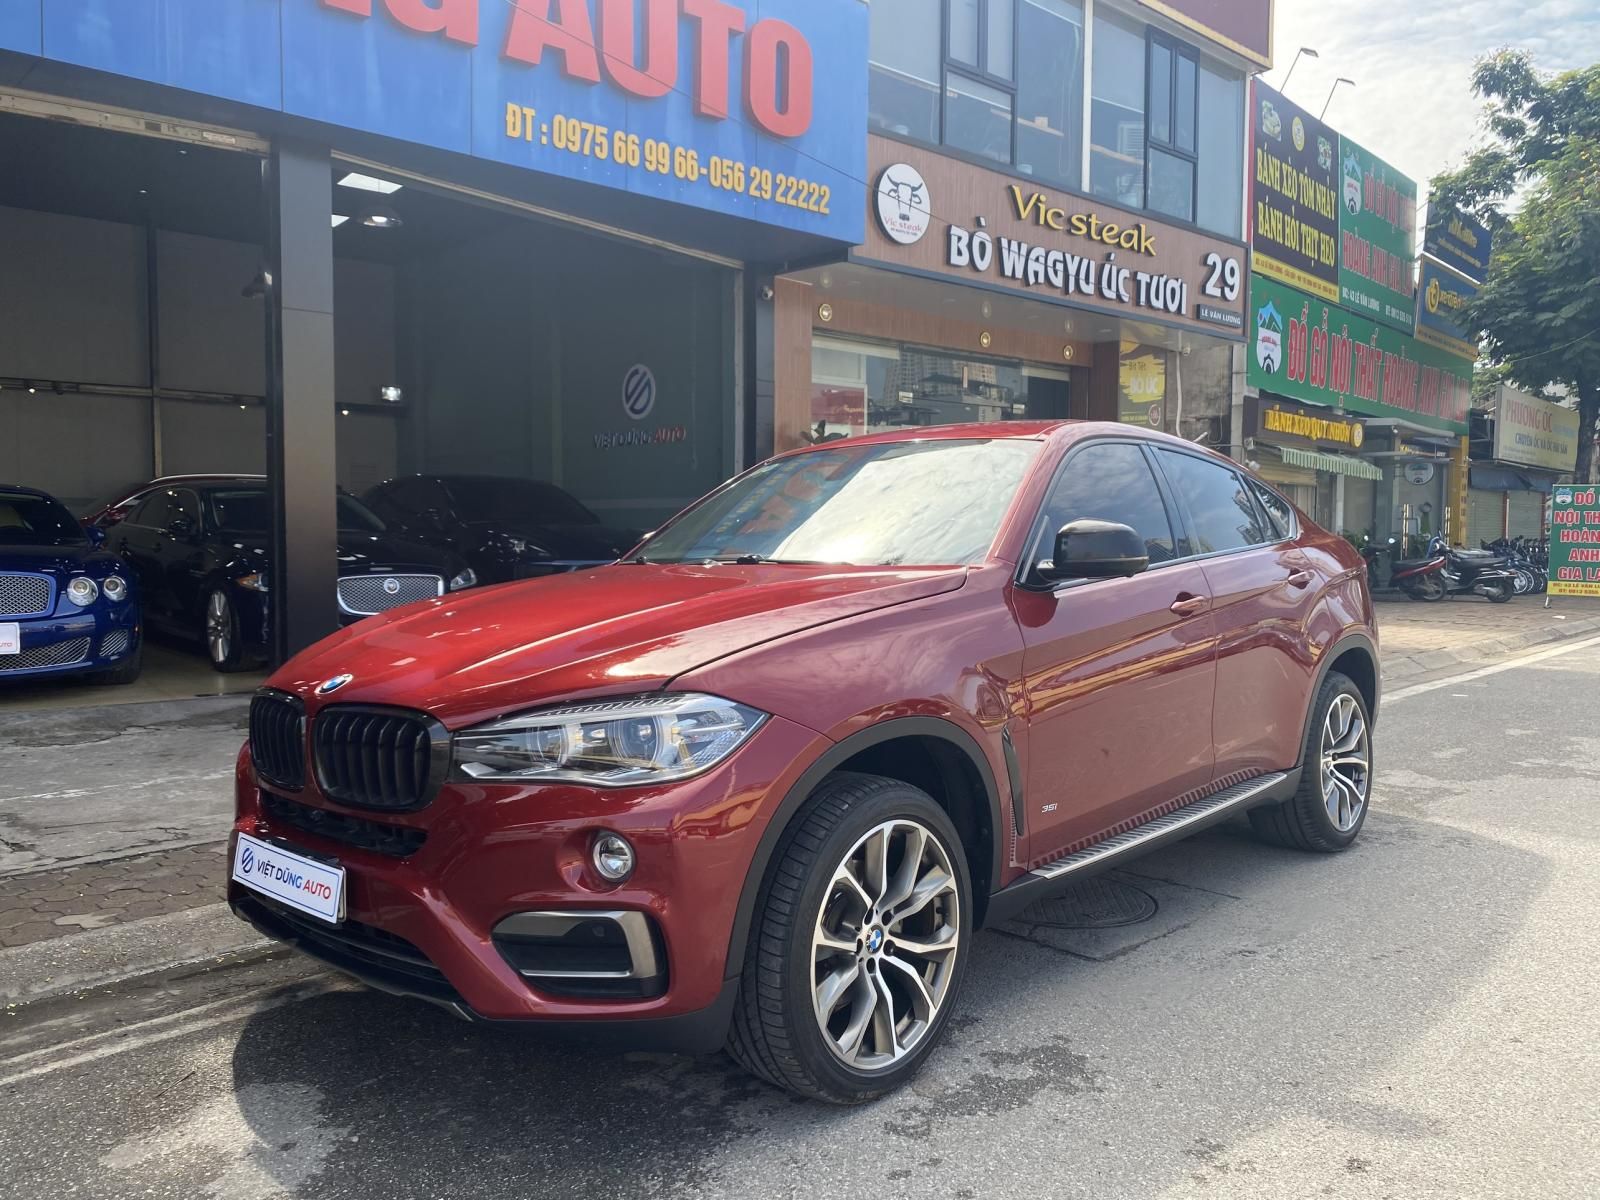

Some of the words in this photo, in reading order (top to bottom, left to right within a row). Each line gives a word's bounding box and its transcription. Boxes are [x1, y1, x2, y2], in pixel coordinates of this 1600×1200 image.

[552, 113, 609, 160] 0975
[613, 130, 640, 168] 66
[644, 138, 670, 175] 99
[749, 166, 772, 200] 29
[775, 173, 831, 215] 22222
[1257, 142, 1281, 192] BÁNH
[1281, 156, 1298, 201] XÈO
[1070, 212, 1156, 257] steak
[1257, 195, 1283, 244] BÁNH
[950, 216, 993, 271] BÒ
[1000, 237, 1096, 295] WAGYU
[1101, 252, 1131, 303] ÚC
[1135, 270, 1188, 315] TƯƠI
[1204, 252, 1240, 301] 29
[1553, 507, 1581, 528] NỘI
[257, 858, 276, 879] VIỆT
[275, 866, 303, 889] DŨNG
[303, 879, 332, 900] AUTO
